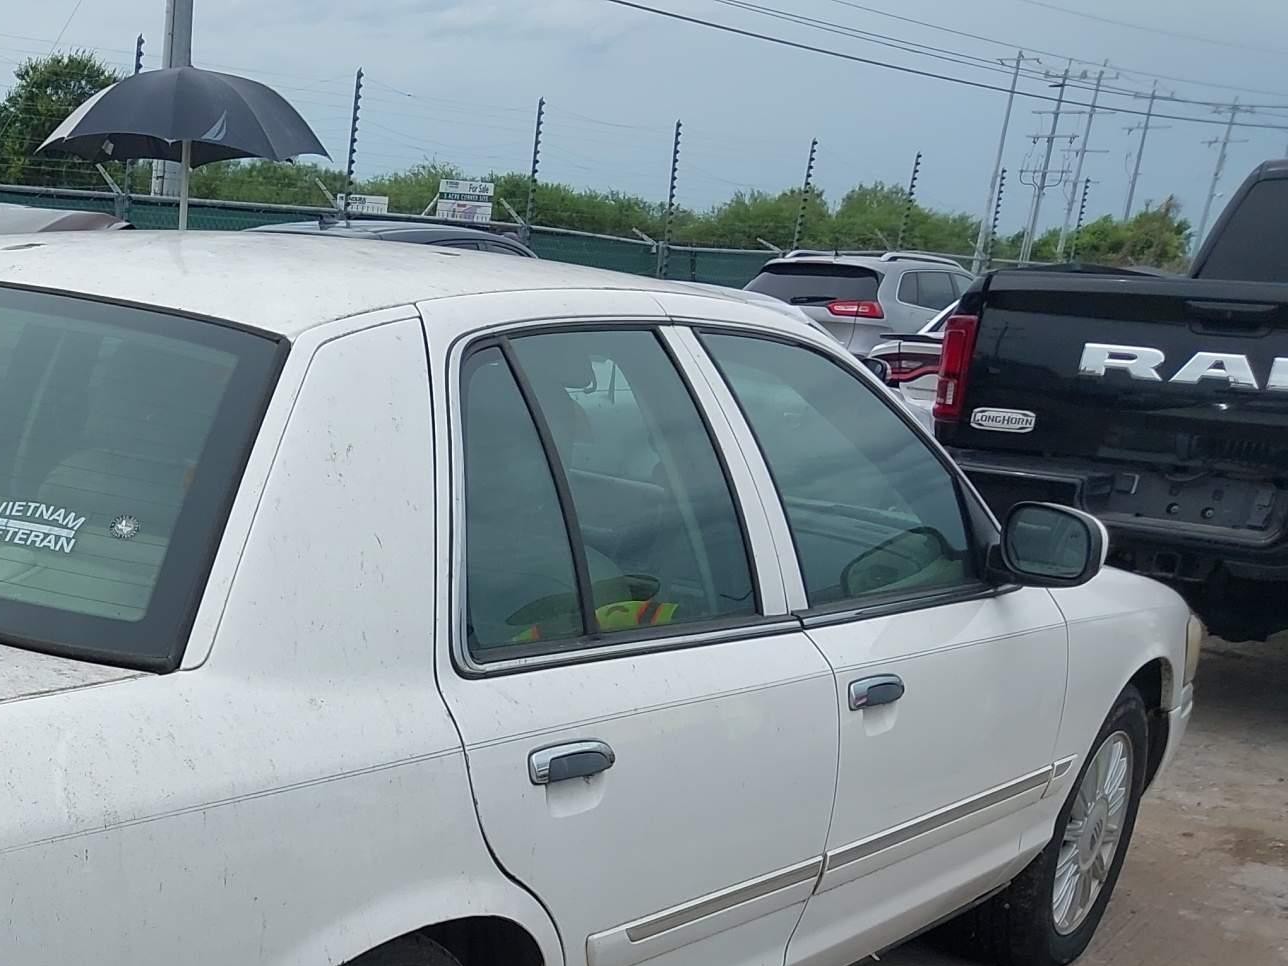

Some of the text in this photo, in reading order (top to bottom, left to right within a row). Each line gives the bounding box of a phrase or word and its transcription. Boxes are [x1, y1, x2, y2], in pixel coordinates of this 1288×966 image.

[469, 183, 478, 192] For
[478, 184, 489, 194] Sale
[1078, 342, 1288, 392] RA
